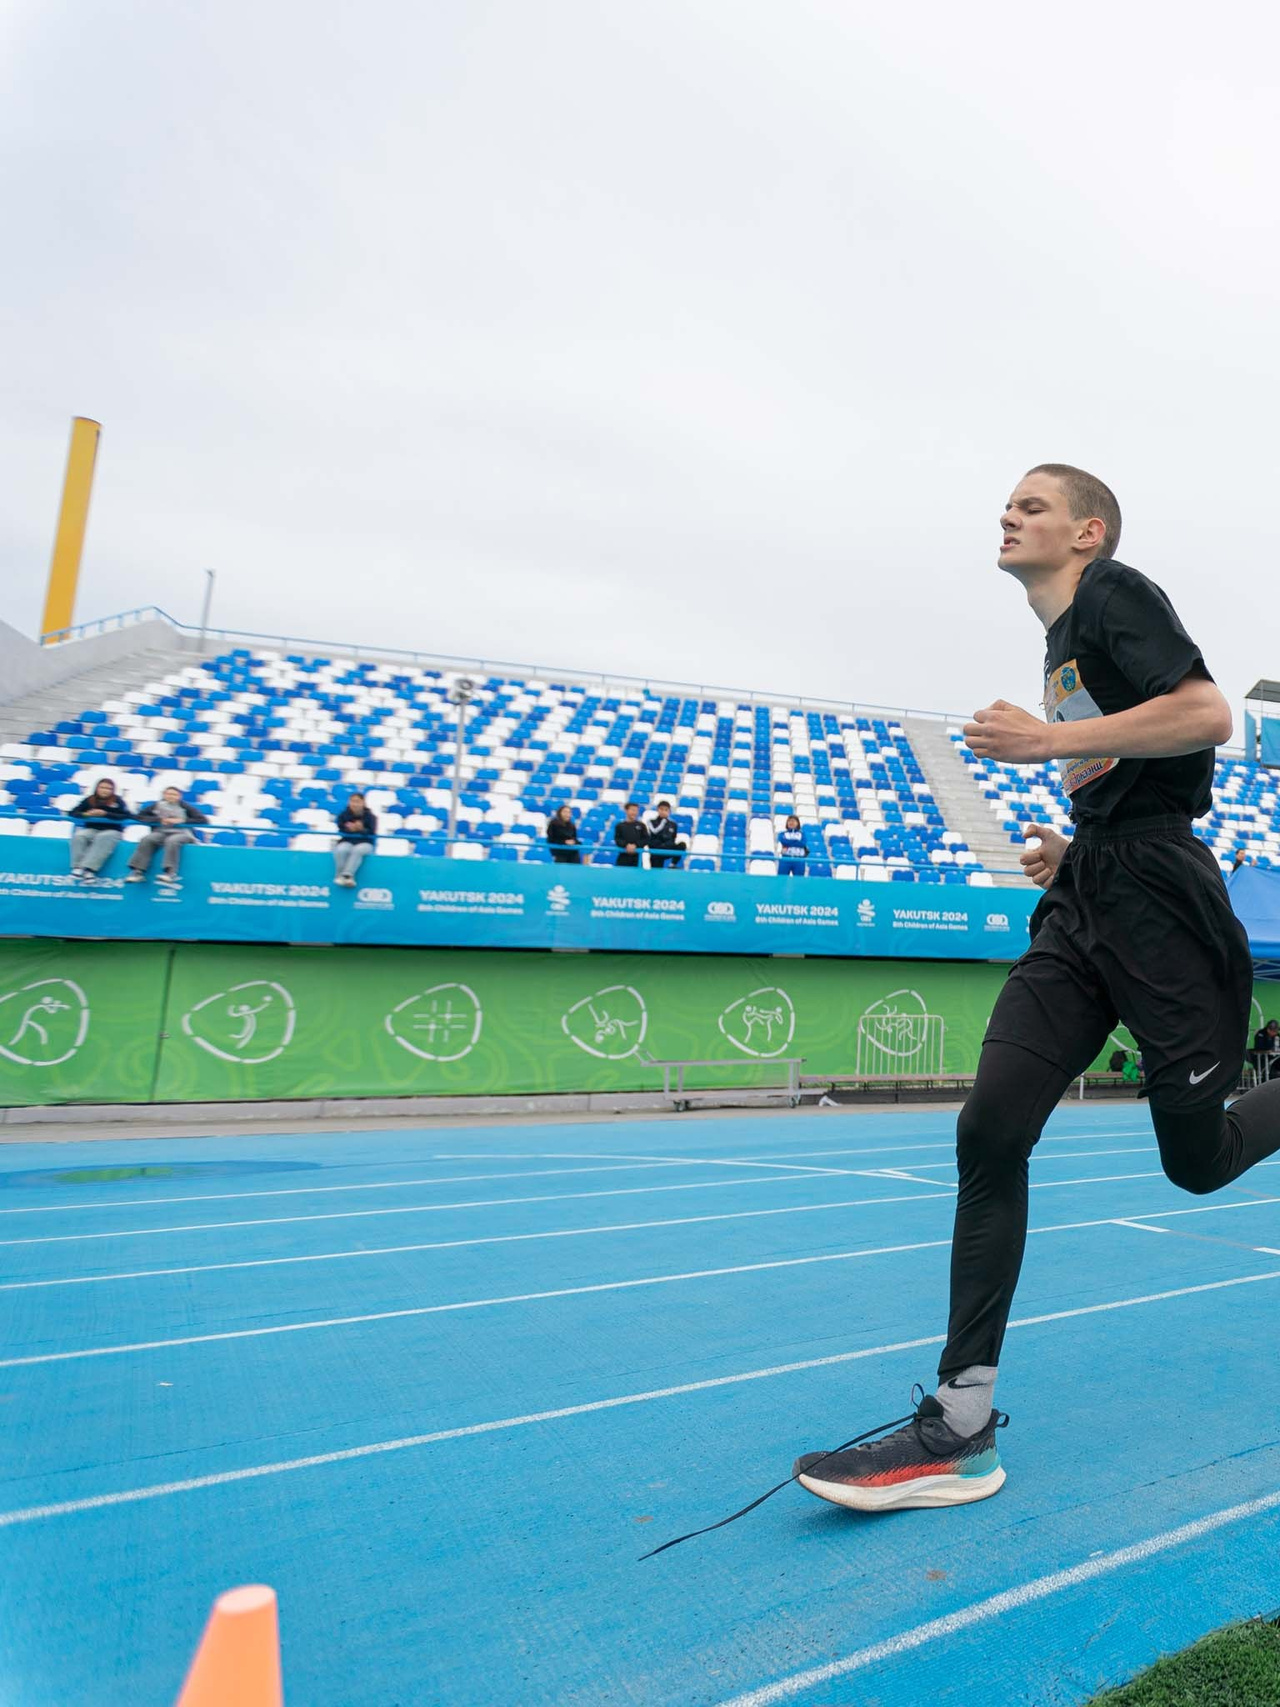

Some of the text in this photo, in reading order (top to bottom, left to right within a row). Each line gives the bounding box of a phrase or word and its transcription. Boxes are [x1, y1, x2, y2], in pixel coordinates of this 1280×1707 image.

[210, 882, 330, 897] YAKUTSK 2024
[419, 890, 524, 904] YAKUTSK 2024
[592, 896, 685, 911] YAKUTSK 2024
[755, 903, 839, 917] YAKUTSK 2024
[893, 909, 969, 922] YAKUTSK 2024
